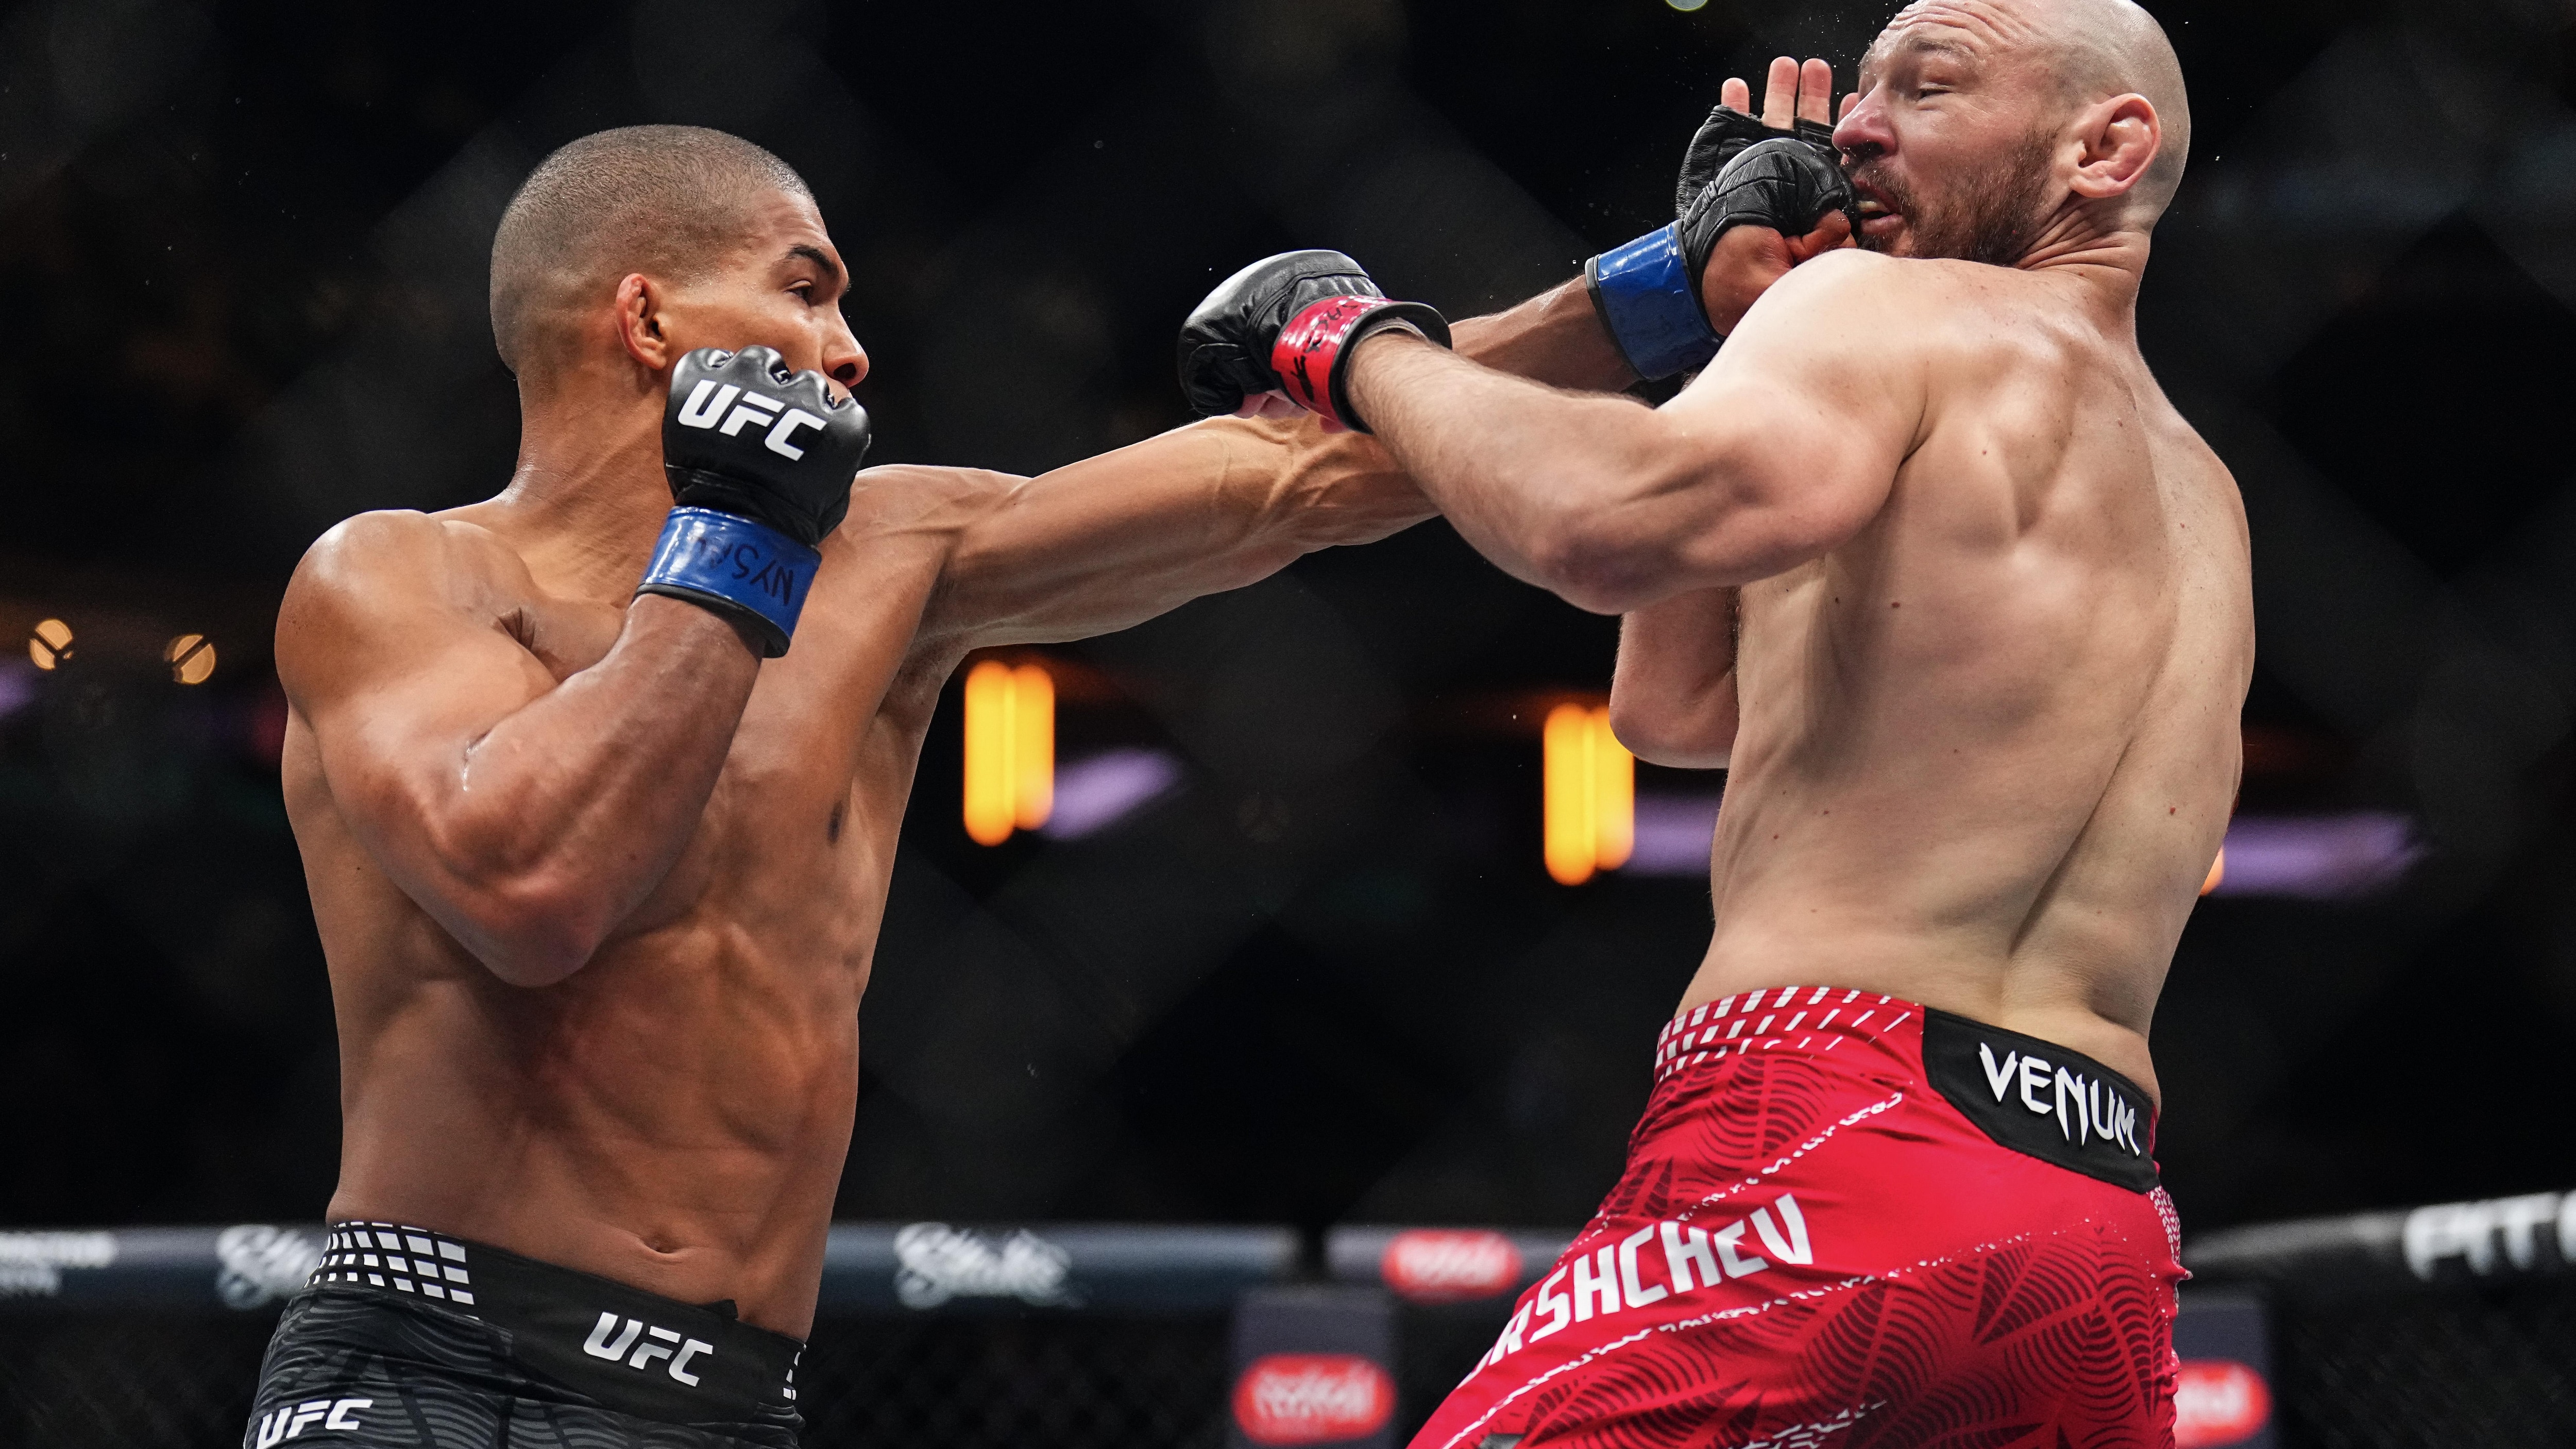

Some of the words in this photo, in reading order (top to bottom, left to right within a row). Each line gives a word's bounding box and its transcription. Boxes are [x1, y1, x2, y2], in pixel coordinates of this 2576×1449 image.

[677, 379, 827, 461] UFC
[1979, 1042, 2141, 1156] VENUM
[1456, 1193, 1813, 1389] RSHCHEV
[583, 1312, 714, 1387] UFC
[257, 1399, 374, 1449] UFC
